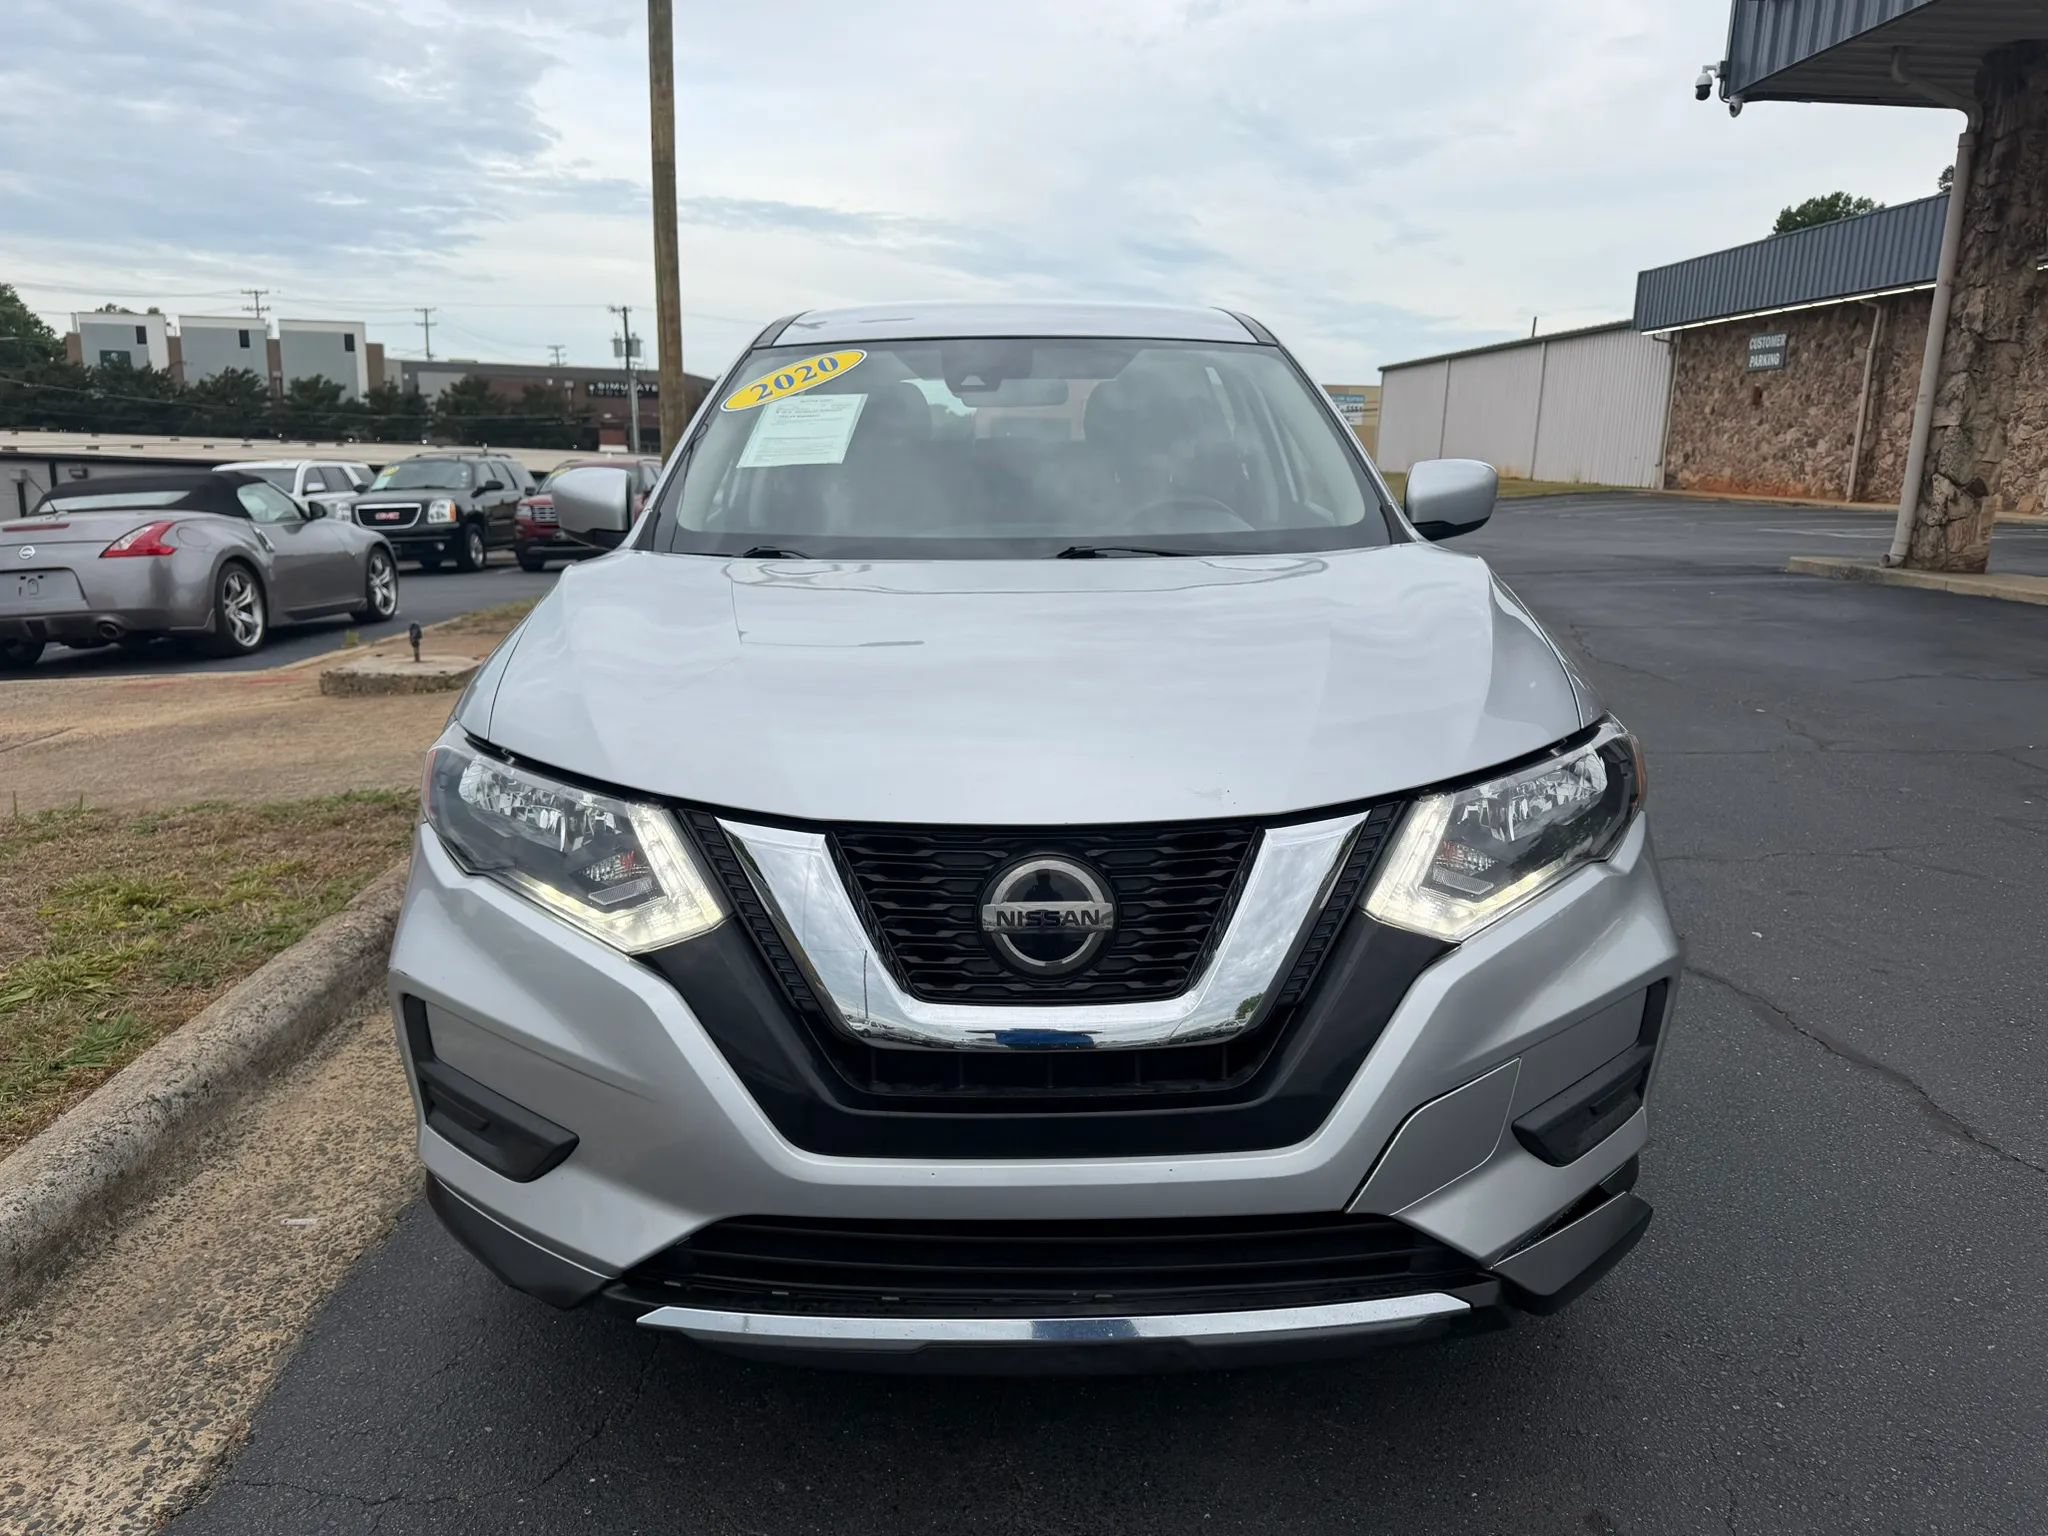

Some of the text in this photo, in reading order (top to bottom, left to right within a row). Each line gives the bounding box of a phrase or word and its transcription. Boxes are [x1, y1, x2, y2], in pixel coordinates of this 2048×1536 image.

[1749, 333, 1787, 350] CUSTOMER
[1749, 353, 1781, 368] PARKING
[750, 357, 839, 402] 2020
[997, 909, 1100, 927] NISSAN
